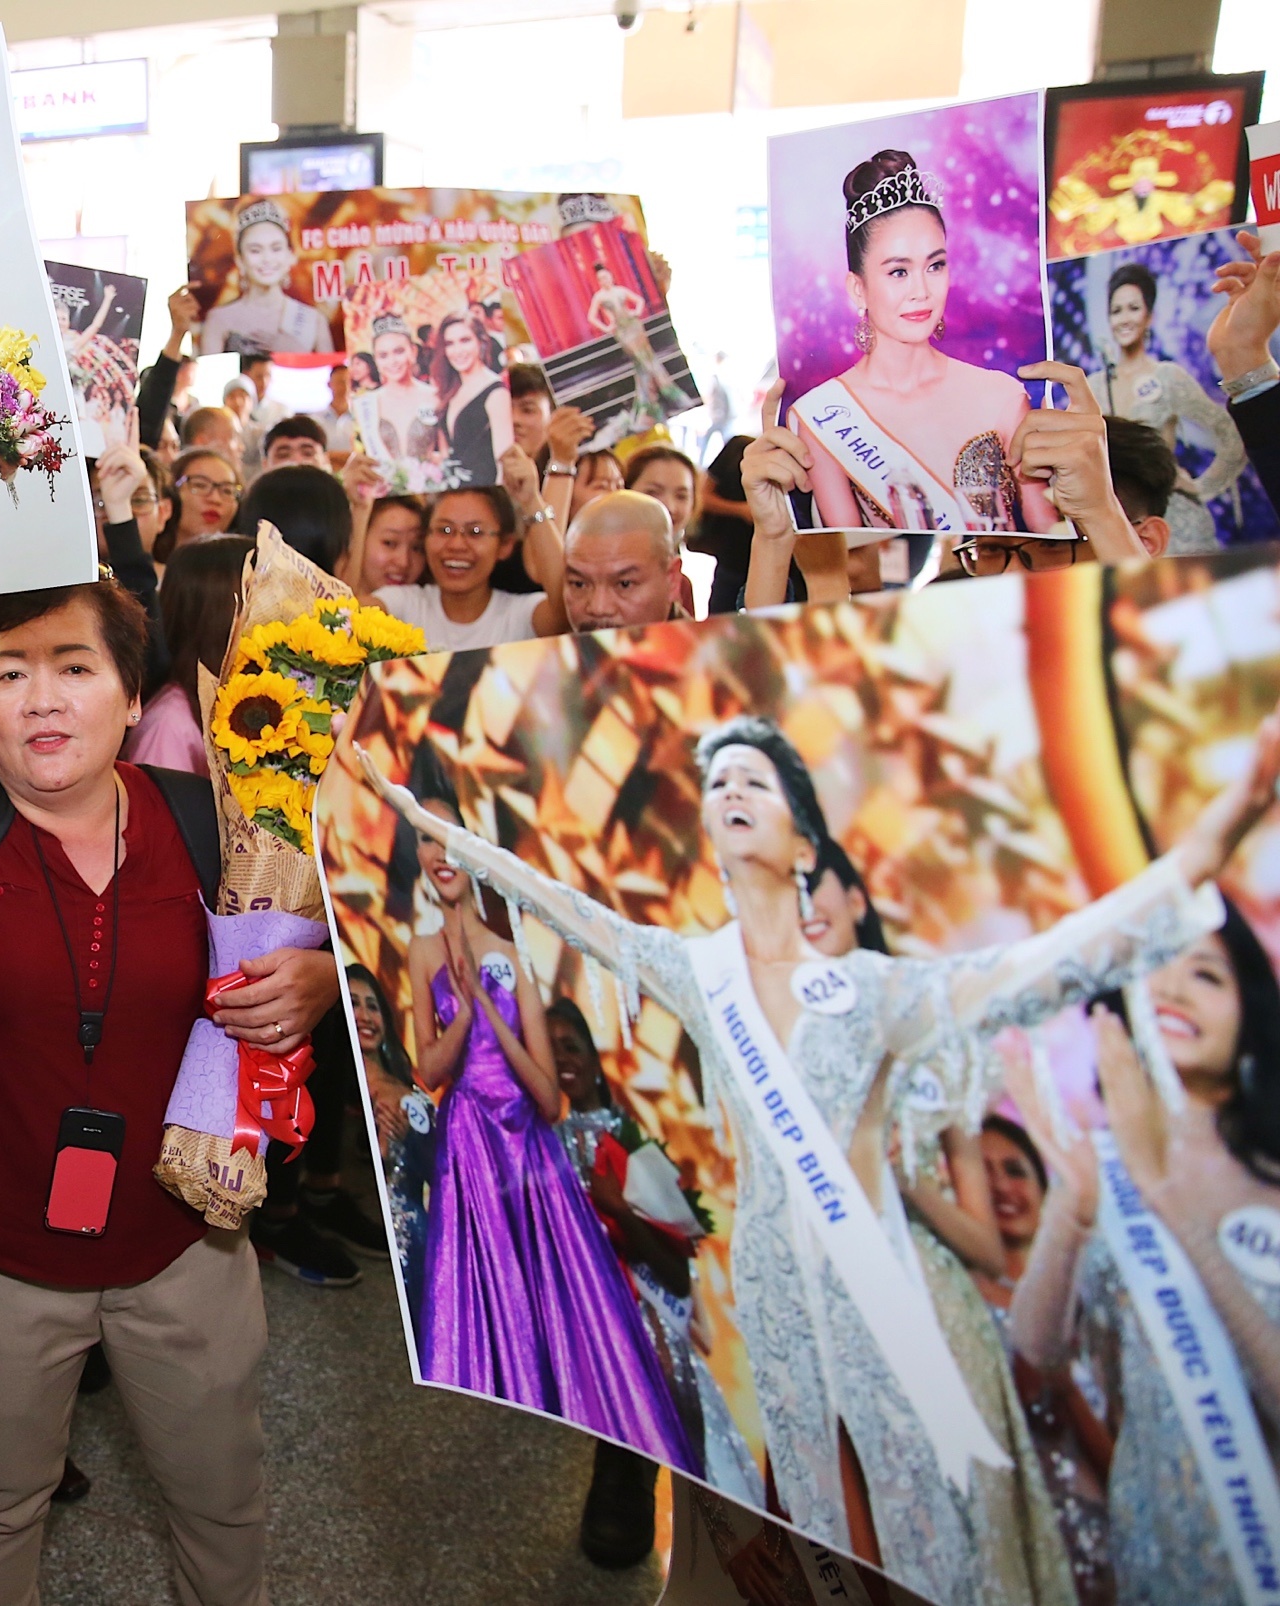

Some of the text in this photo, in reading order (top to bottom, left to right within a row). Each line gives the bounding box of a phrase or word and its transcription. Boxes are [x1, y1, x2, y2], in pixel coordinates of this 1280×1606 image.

[14, 90, 96, 109] BANK
[302, 228, 323, 249] FC
[326, 222, 370, 248] CHÀO
[49, 282, 87, 300] ERSE
[835, 425, 885, 471] Á HẬU
[801, 970, 848, 1004] 424
[763, 1088, 805, 1144] ĐẸP
[1228, 1221, 1280, 1256] 40
